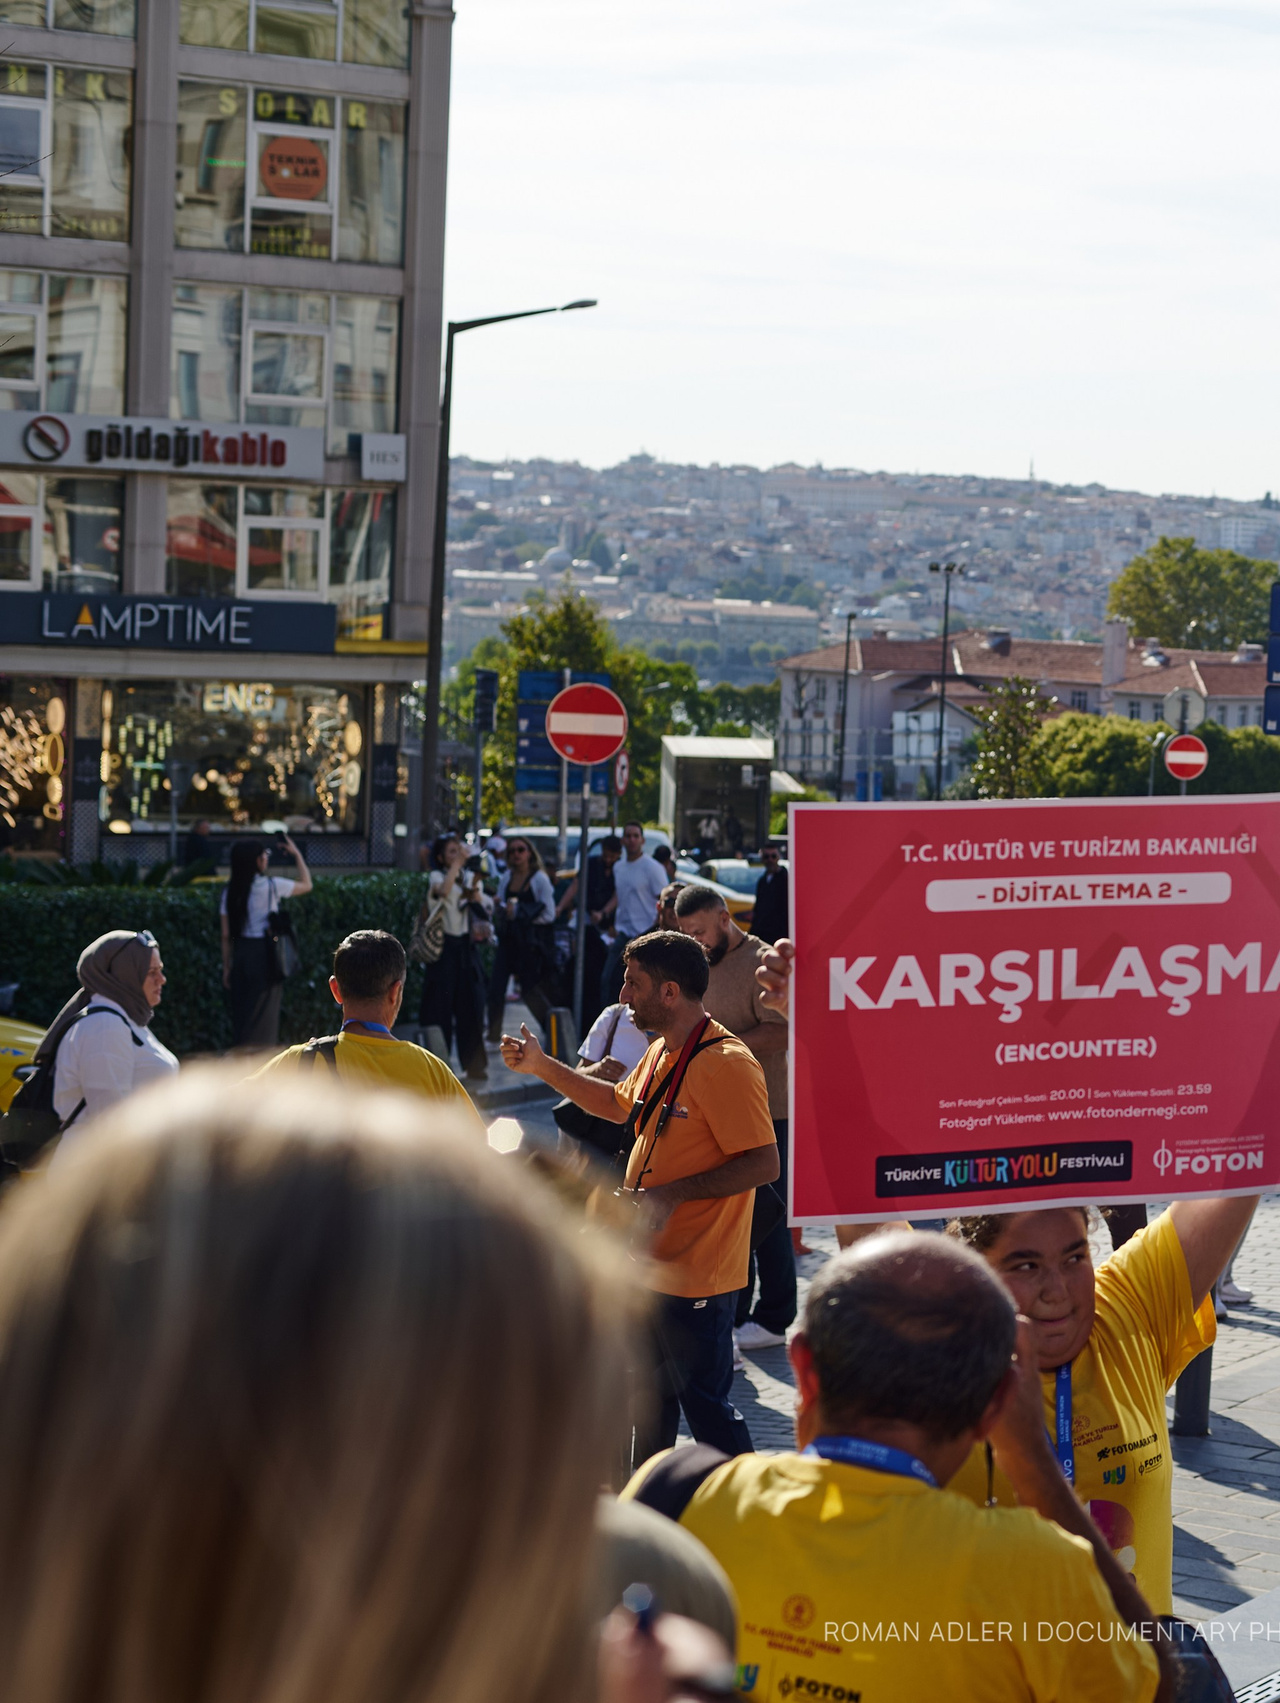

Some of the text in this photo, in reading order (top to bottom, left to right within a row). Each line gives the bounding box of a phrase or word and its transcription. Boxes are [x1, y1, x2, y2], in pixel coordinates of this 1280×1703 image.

[218, 88, 367, 128] SOLAR
[43, 600, 254, 645] LAMPTIME
[901, 832, 1258, 863] T.C. KÜLTÜR VE TURİZM BAKANLIĞI
[993, 880, 1082, 903] DİJİTAL
[1088, 881, 1152, 900] TEMA
[1157, 881, 1173, 898] 2
[995, 1035, 1157, 1065] (ENCOUNTER)
[1050, 1088, 1086, 1101] 20.00
[1094, 1089, 1111, 1099] Son
[1177, 1083, 1212, 1096] 23.59
[939, 1104, 1209, 1131] Fotoğraf Yükleme: www.fotondernegi.com
[884, 1166, 942, 1182] TÜRKİYE
[944, 1151, 1058, 1188] KÜLTÜR YOLU
[1060, 1153, 1124, 1169] FESTİVALİ
[1174, 1150, 1264, 1176] FOTON
[1073, 1435, 1104, 1448] AKANLIĞI
